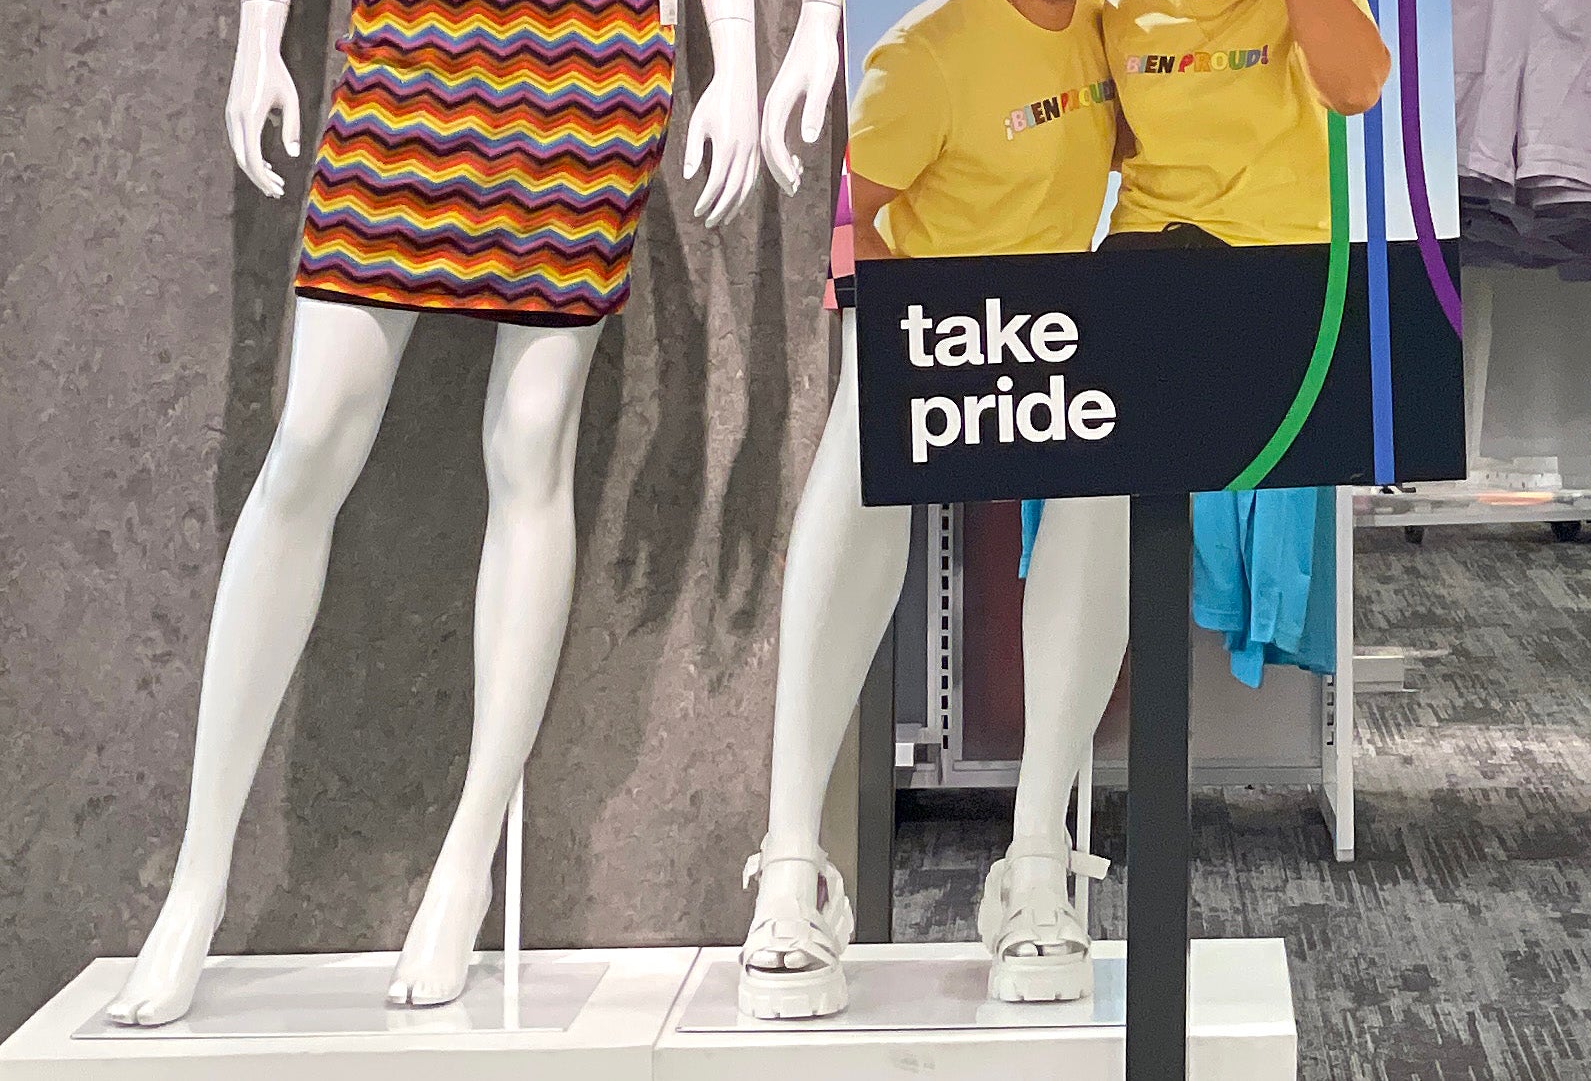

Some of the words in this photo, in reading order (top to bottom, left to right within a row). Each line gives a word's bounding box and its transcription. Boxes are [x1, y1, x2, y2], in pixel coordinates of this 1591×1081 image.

[1178, 44, 1269, 73] PROUD!
[900, 297, 1079, 367] take
[910, 374, 1117, 463] pride
